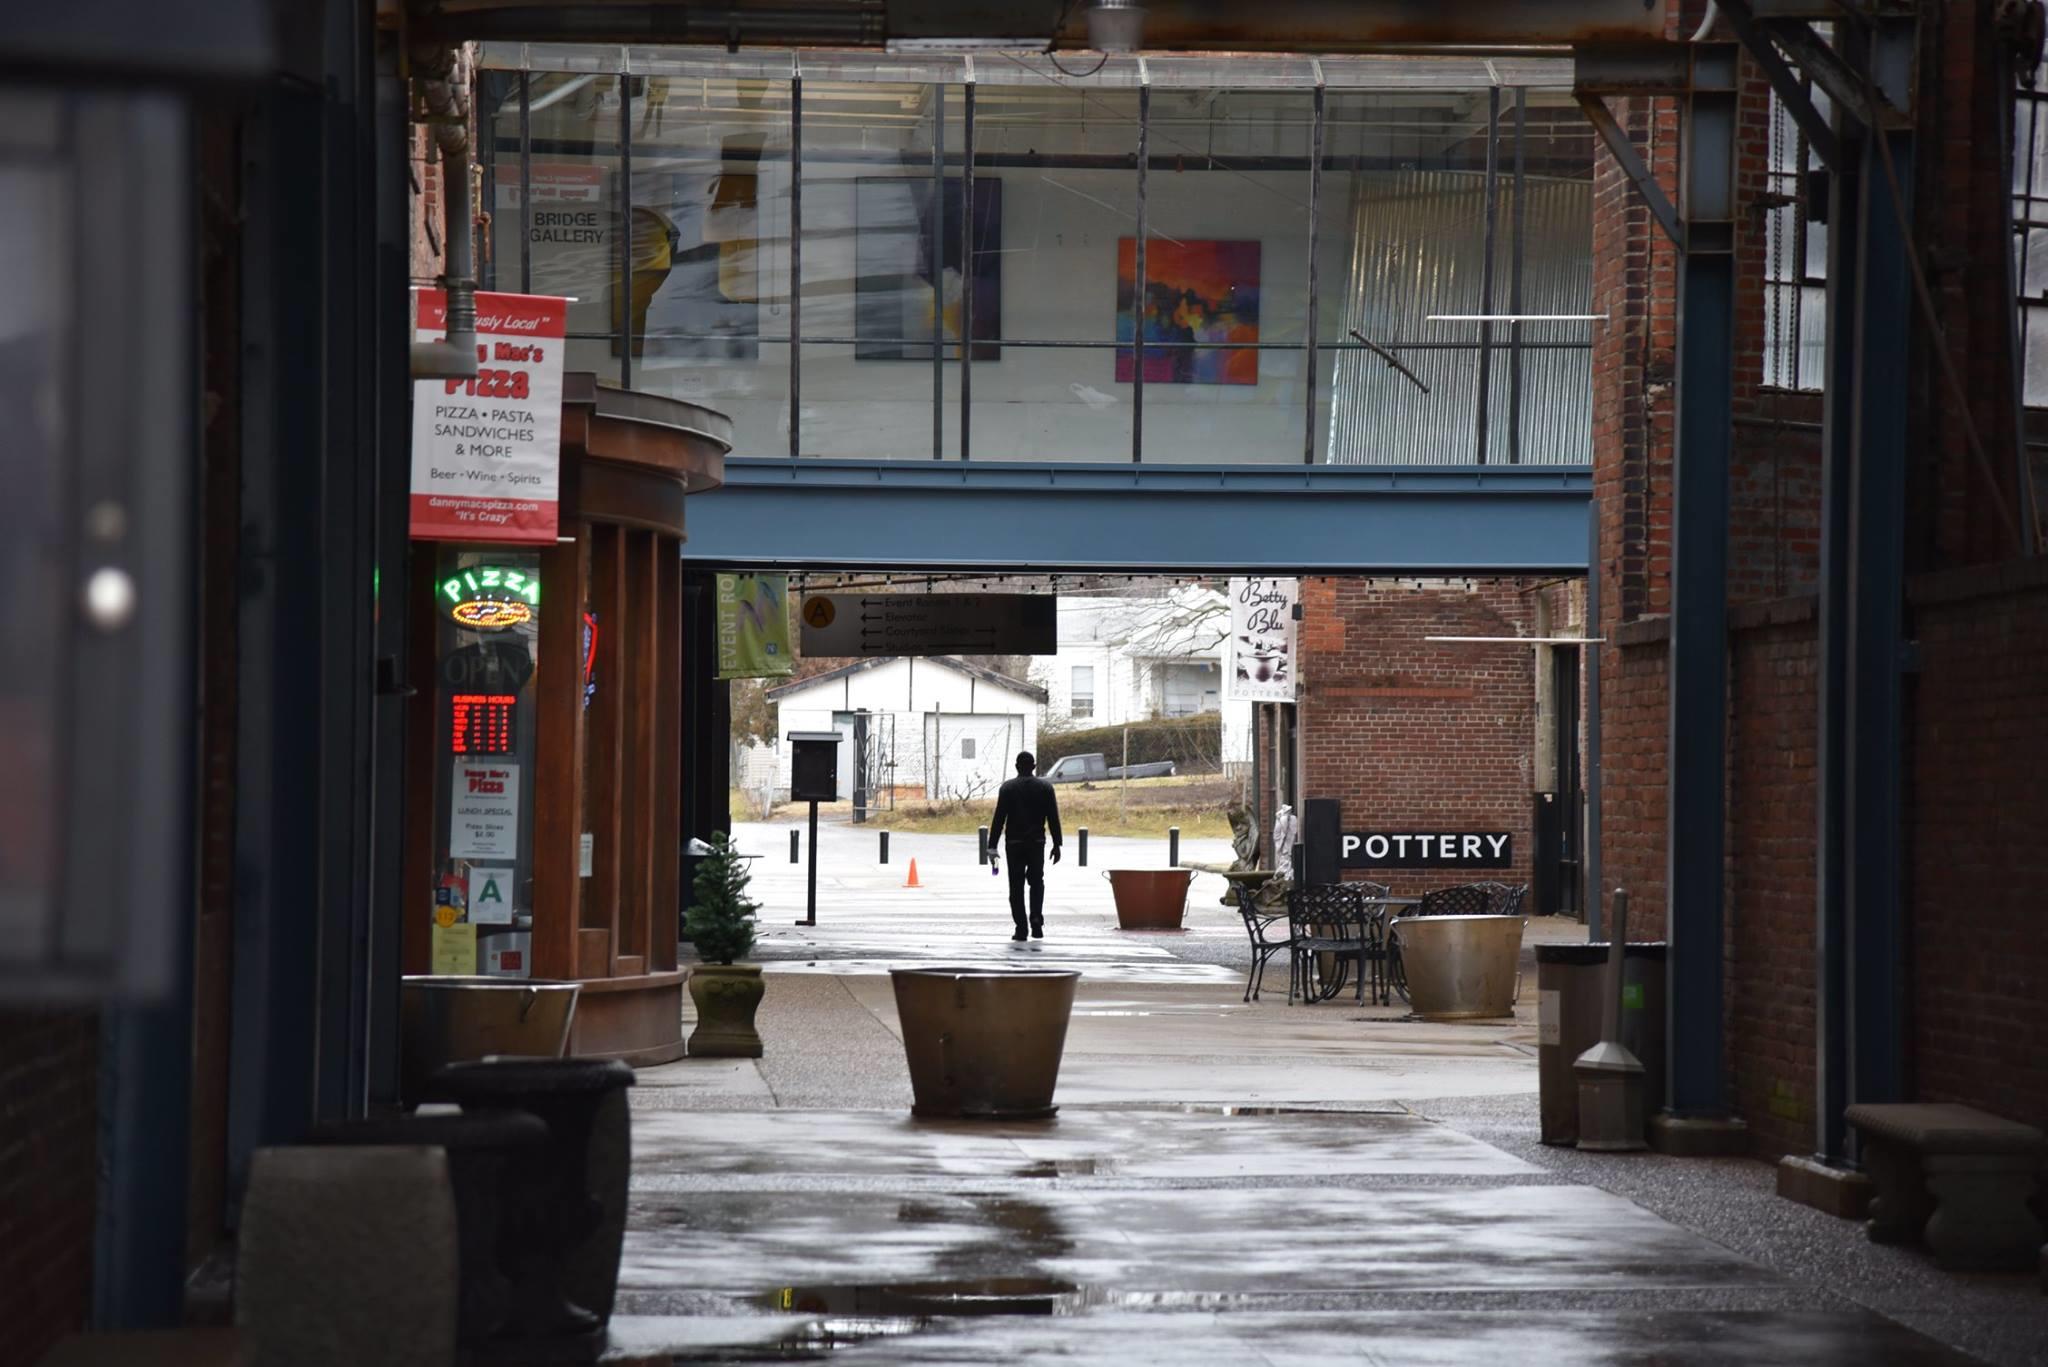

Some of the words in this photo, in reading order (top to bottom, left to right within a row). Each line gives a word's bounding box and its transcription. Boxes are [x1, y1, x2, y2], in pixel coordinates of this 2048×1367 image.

[534, 212, 598, 227] BRIDGE
[530, 229, 604, 244] GALLERY
[495, 342, 544, 363] Mac's
[436, 406, 479, 420] PIZZA
[492, 409, 535, 424] PASTA
[434, 424, 534, 442] SANDWICHES
[455, 443, 465, 456] &
[470, 444, 513, 458] MORE
[430, 468, 457, 479] Beer
[466, 470, 497, 482] Wine
[507, 472, 542, 485] Spirits
[429, 497, 539, 511] dannymacspizza.com
[443, 570, 540, 605] PIZZA
[1239, 580, 1289, 609] Betty
[811, 601, 829, 624] A
[885, 599, 913, 608] Event
[885, 613, 928, 622] Elevator
[1247, 608, 1285, 634] Blu
[719, 610, 737, 670] EVENT
[886, 626, 937, 637] Courtyard
[1233, 689, 1289, 697] POTTERY
[1342, 834, 1508, 859] POTTERY
[478, 879, 502, 903] A
